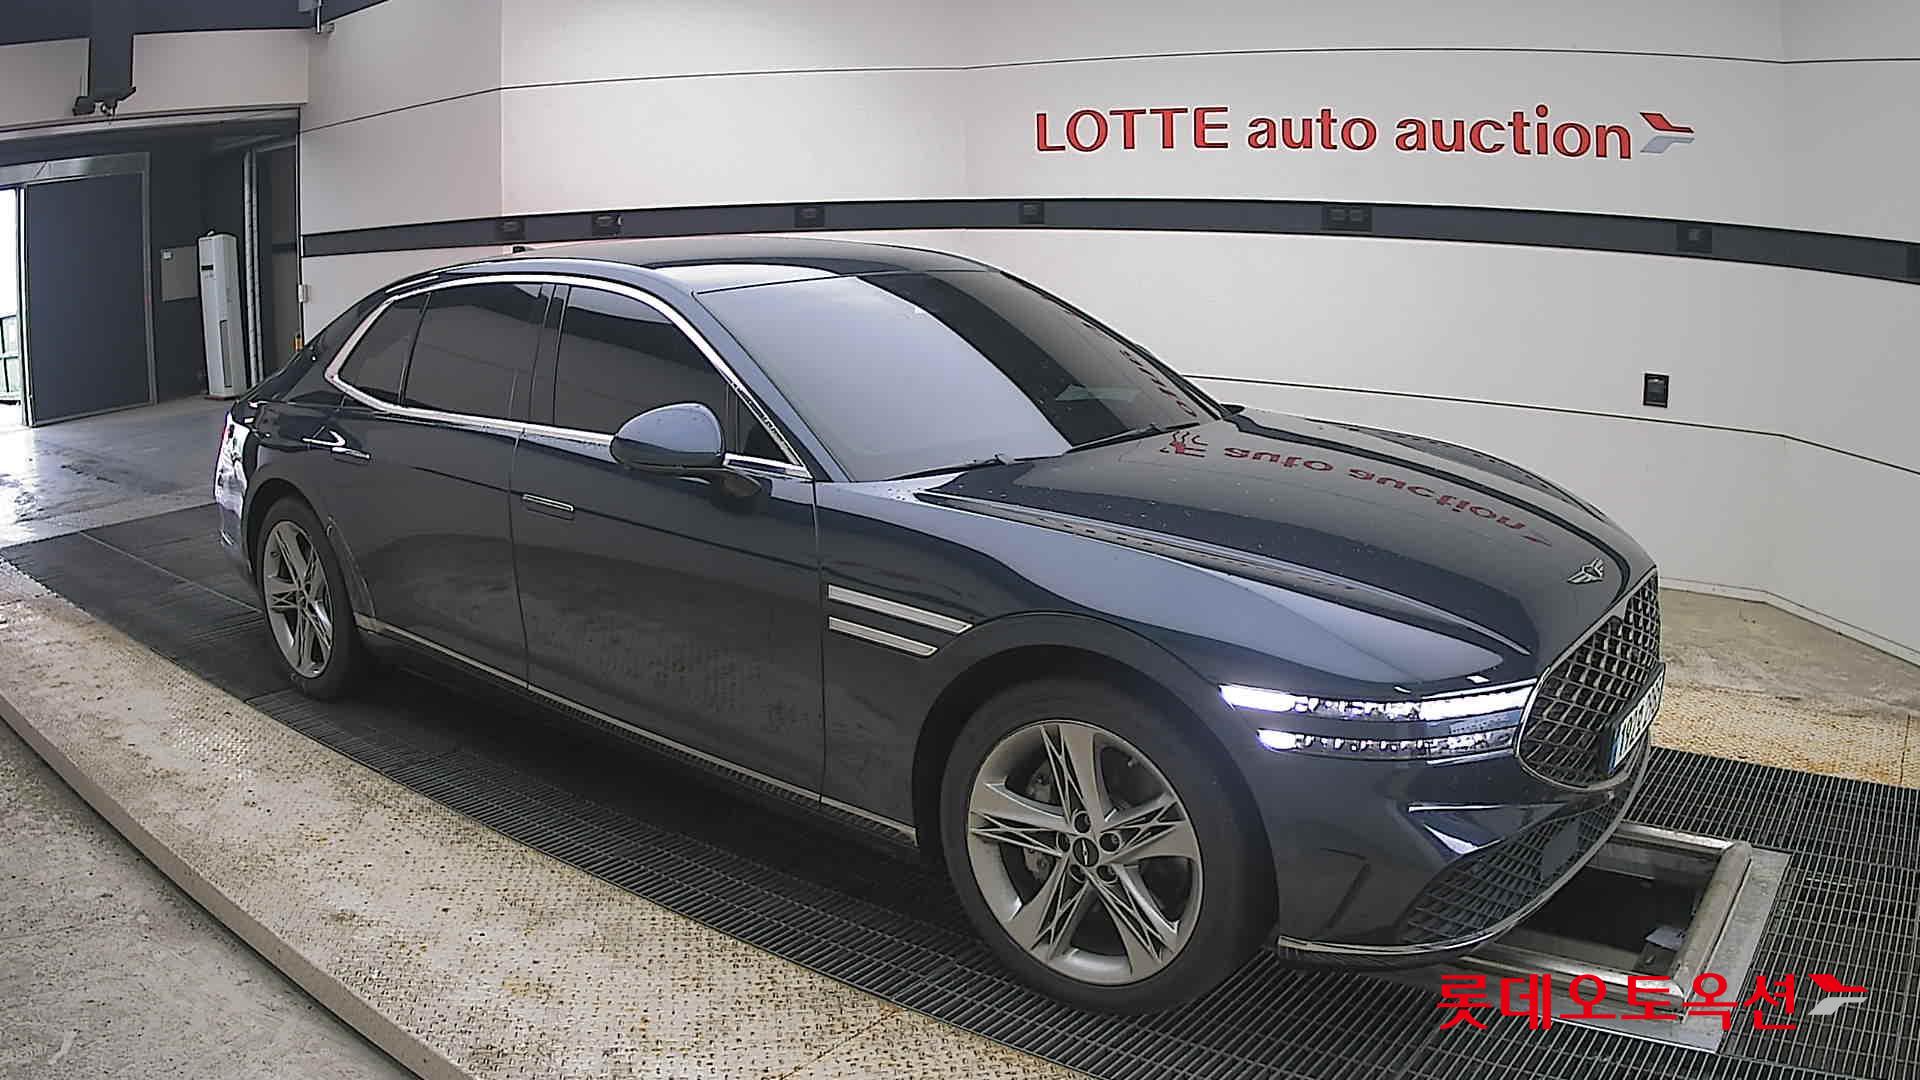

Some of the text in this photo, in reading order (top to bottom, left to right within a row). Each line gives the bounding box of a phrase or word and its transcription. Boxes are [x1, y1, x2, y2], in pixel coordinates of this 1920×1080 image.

[1035, 104, 1632, 159] LOTTE auto auction
